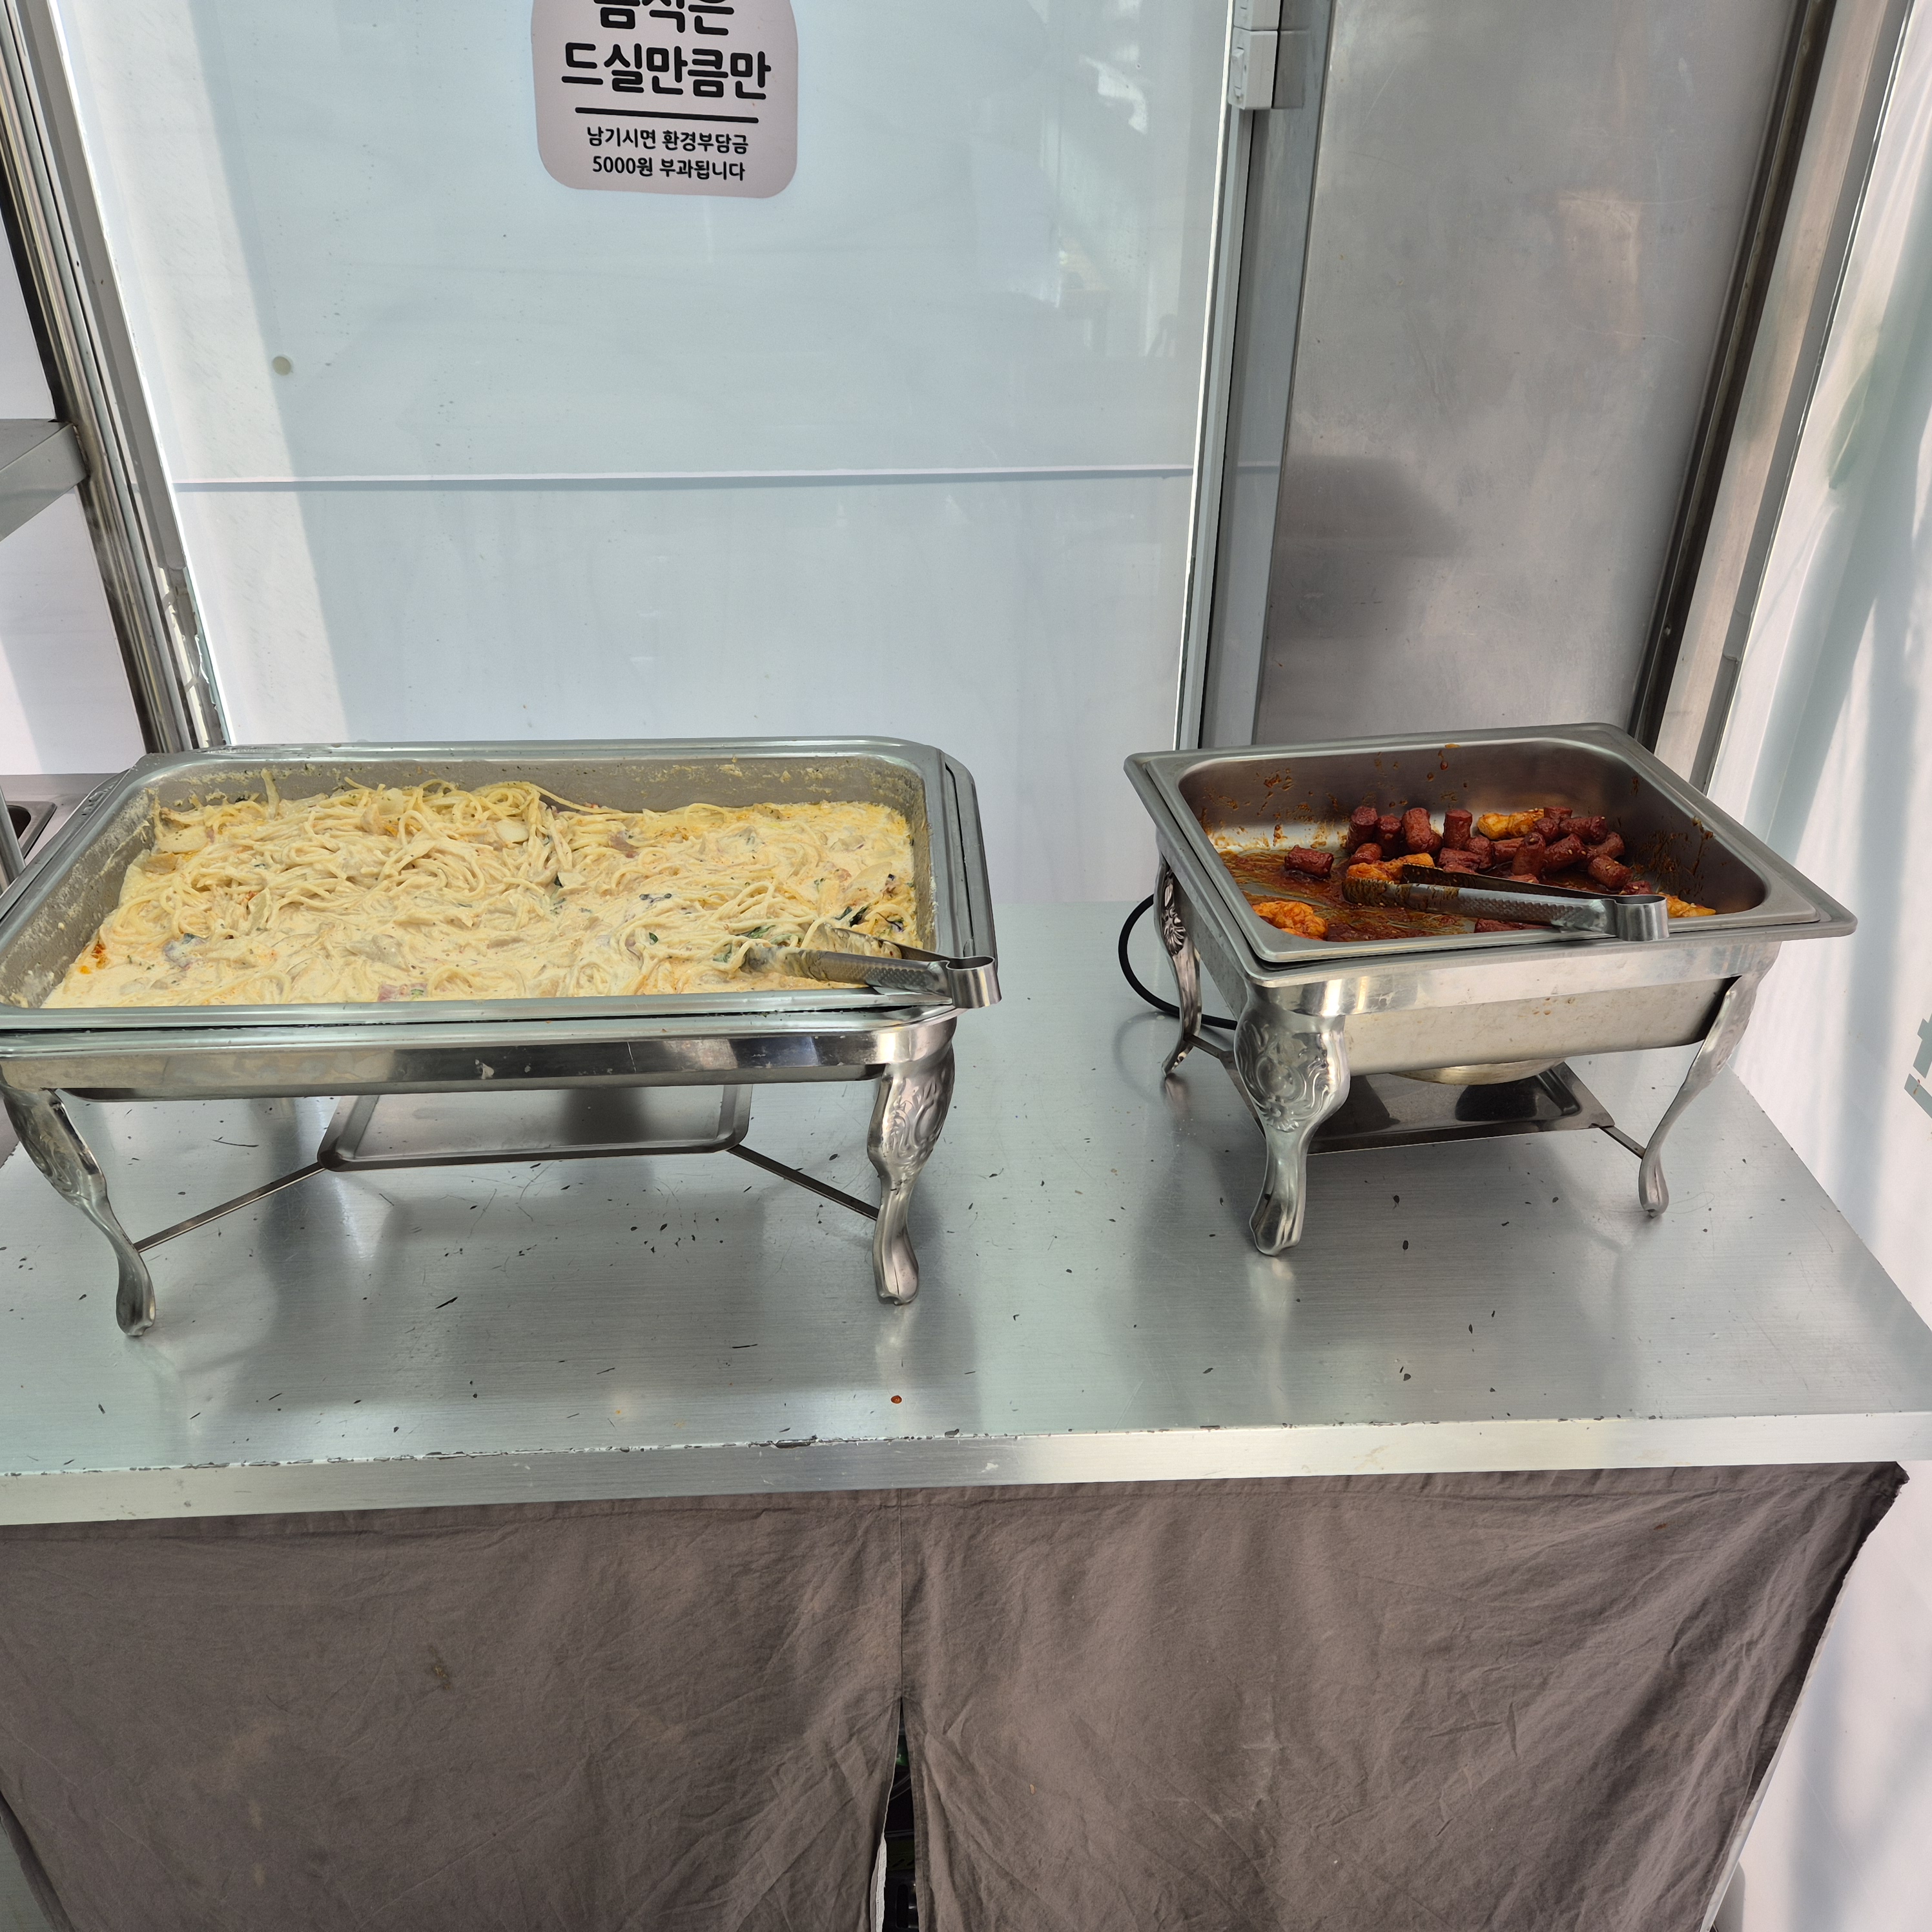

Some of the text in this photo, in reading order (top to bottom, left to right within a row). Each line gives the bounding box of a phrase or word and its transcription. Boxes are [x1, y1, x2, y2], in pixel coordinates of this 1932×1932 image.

[561, 42, 772, 100] 드실만큼만
[586, 126, 750, 155] 남기시면 환경부담금
[592, 156, 746, 181] 5000원 부과됩니다
